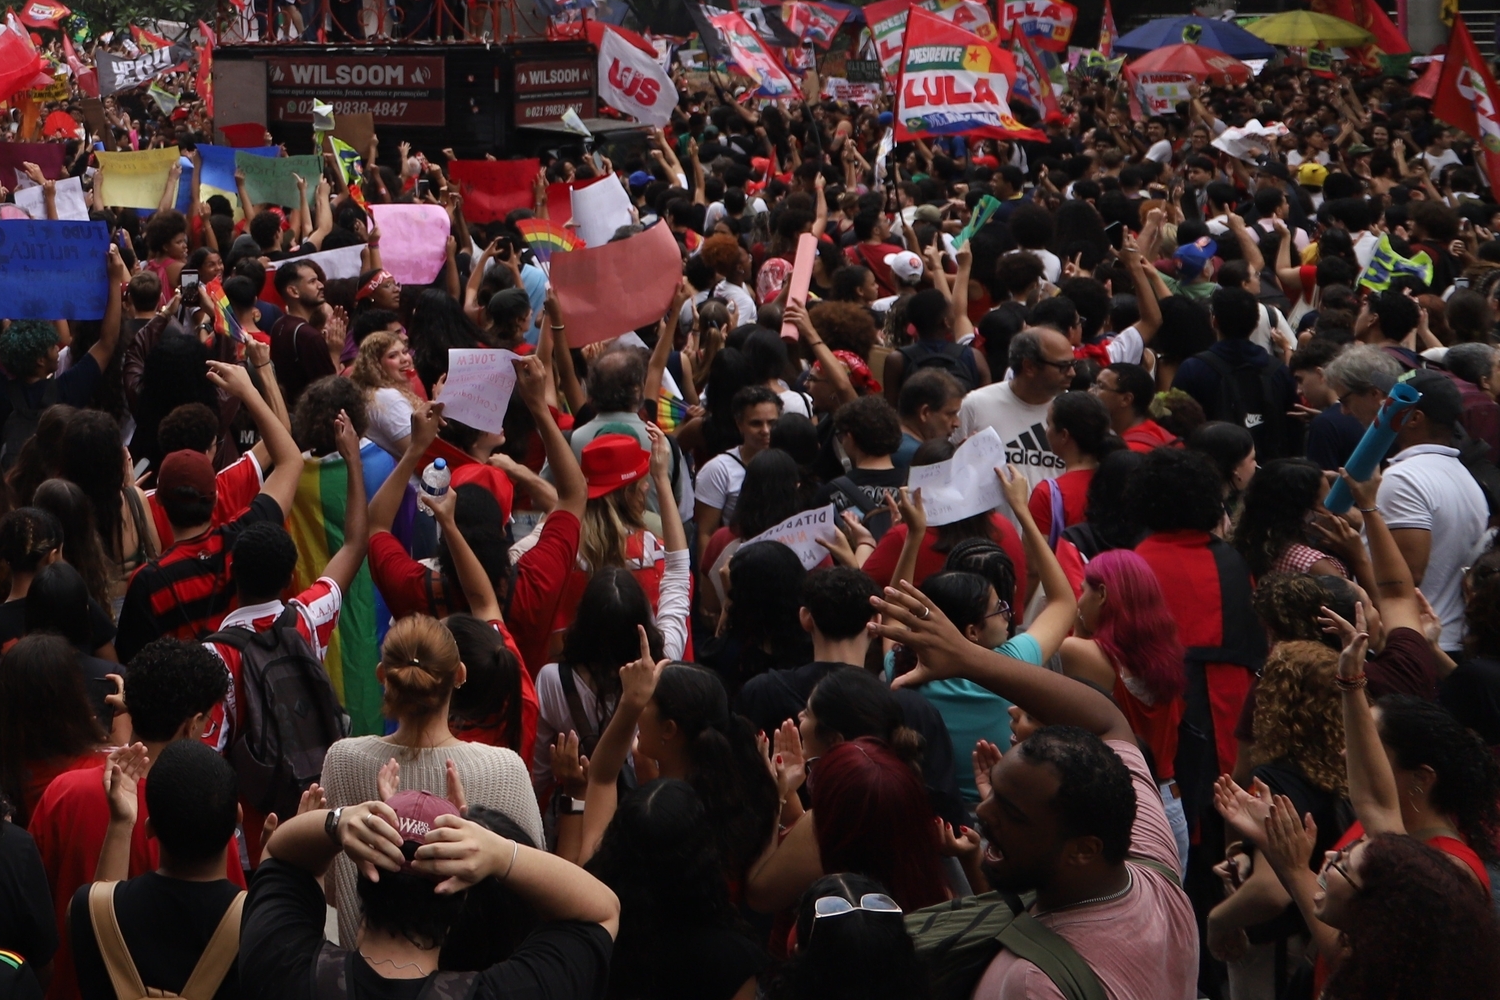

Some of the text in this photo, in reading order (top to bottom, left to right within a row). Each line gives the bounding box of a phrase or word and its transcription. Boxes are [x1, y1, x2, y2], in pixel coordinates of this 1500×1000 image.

[907, 47, 963, 65] PRESIDENTE
[290, 65, 404, 85] WILSOOM
[530, 68, 580, 85] WILSOOM
[904, 75, 999, 109] LULA
[333, 101, 407, 117] 9838-4847
[1005, 448, 1067, 470] adidas
